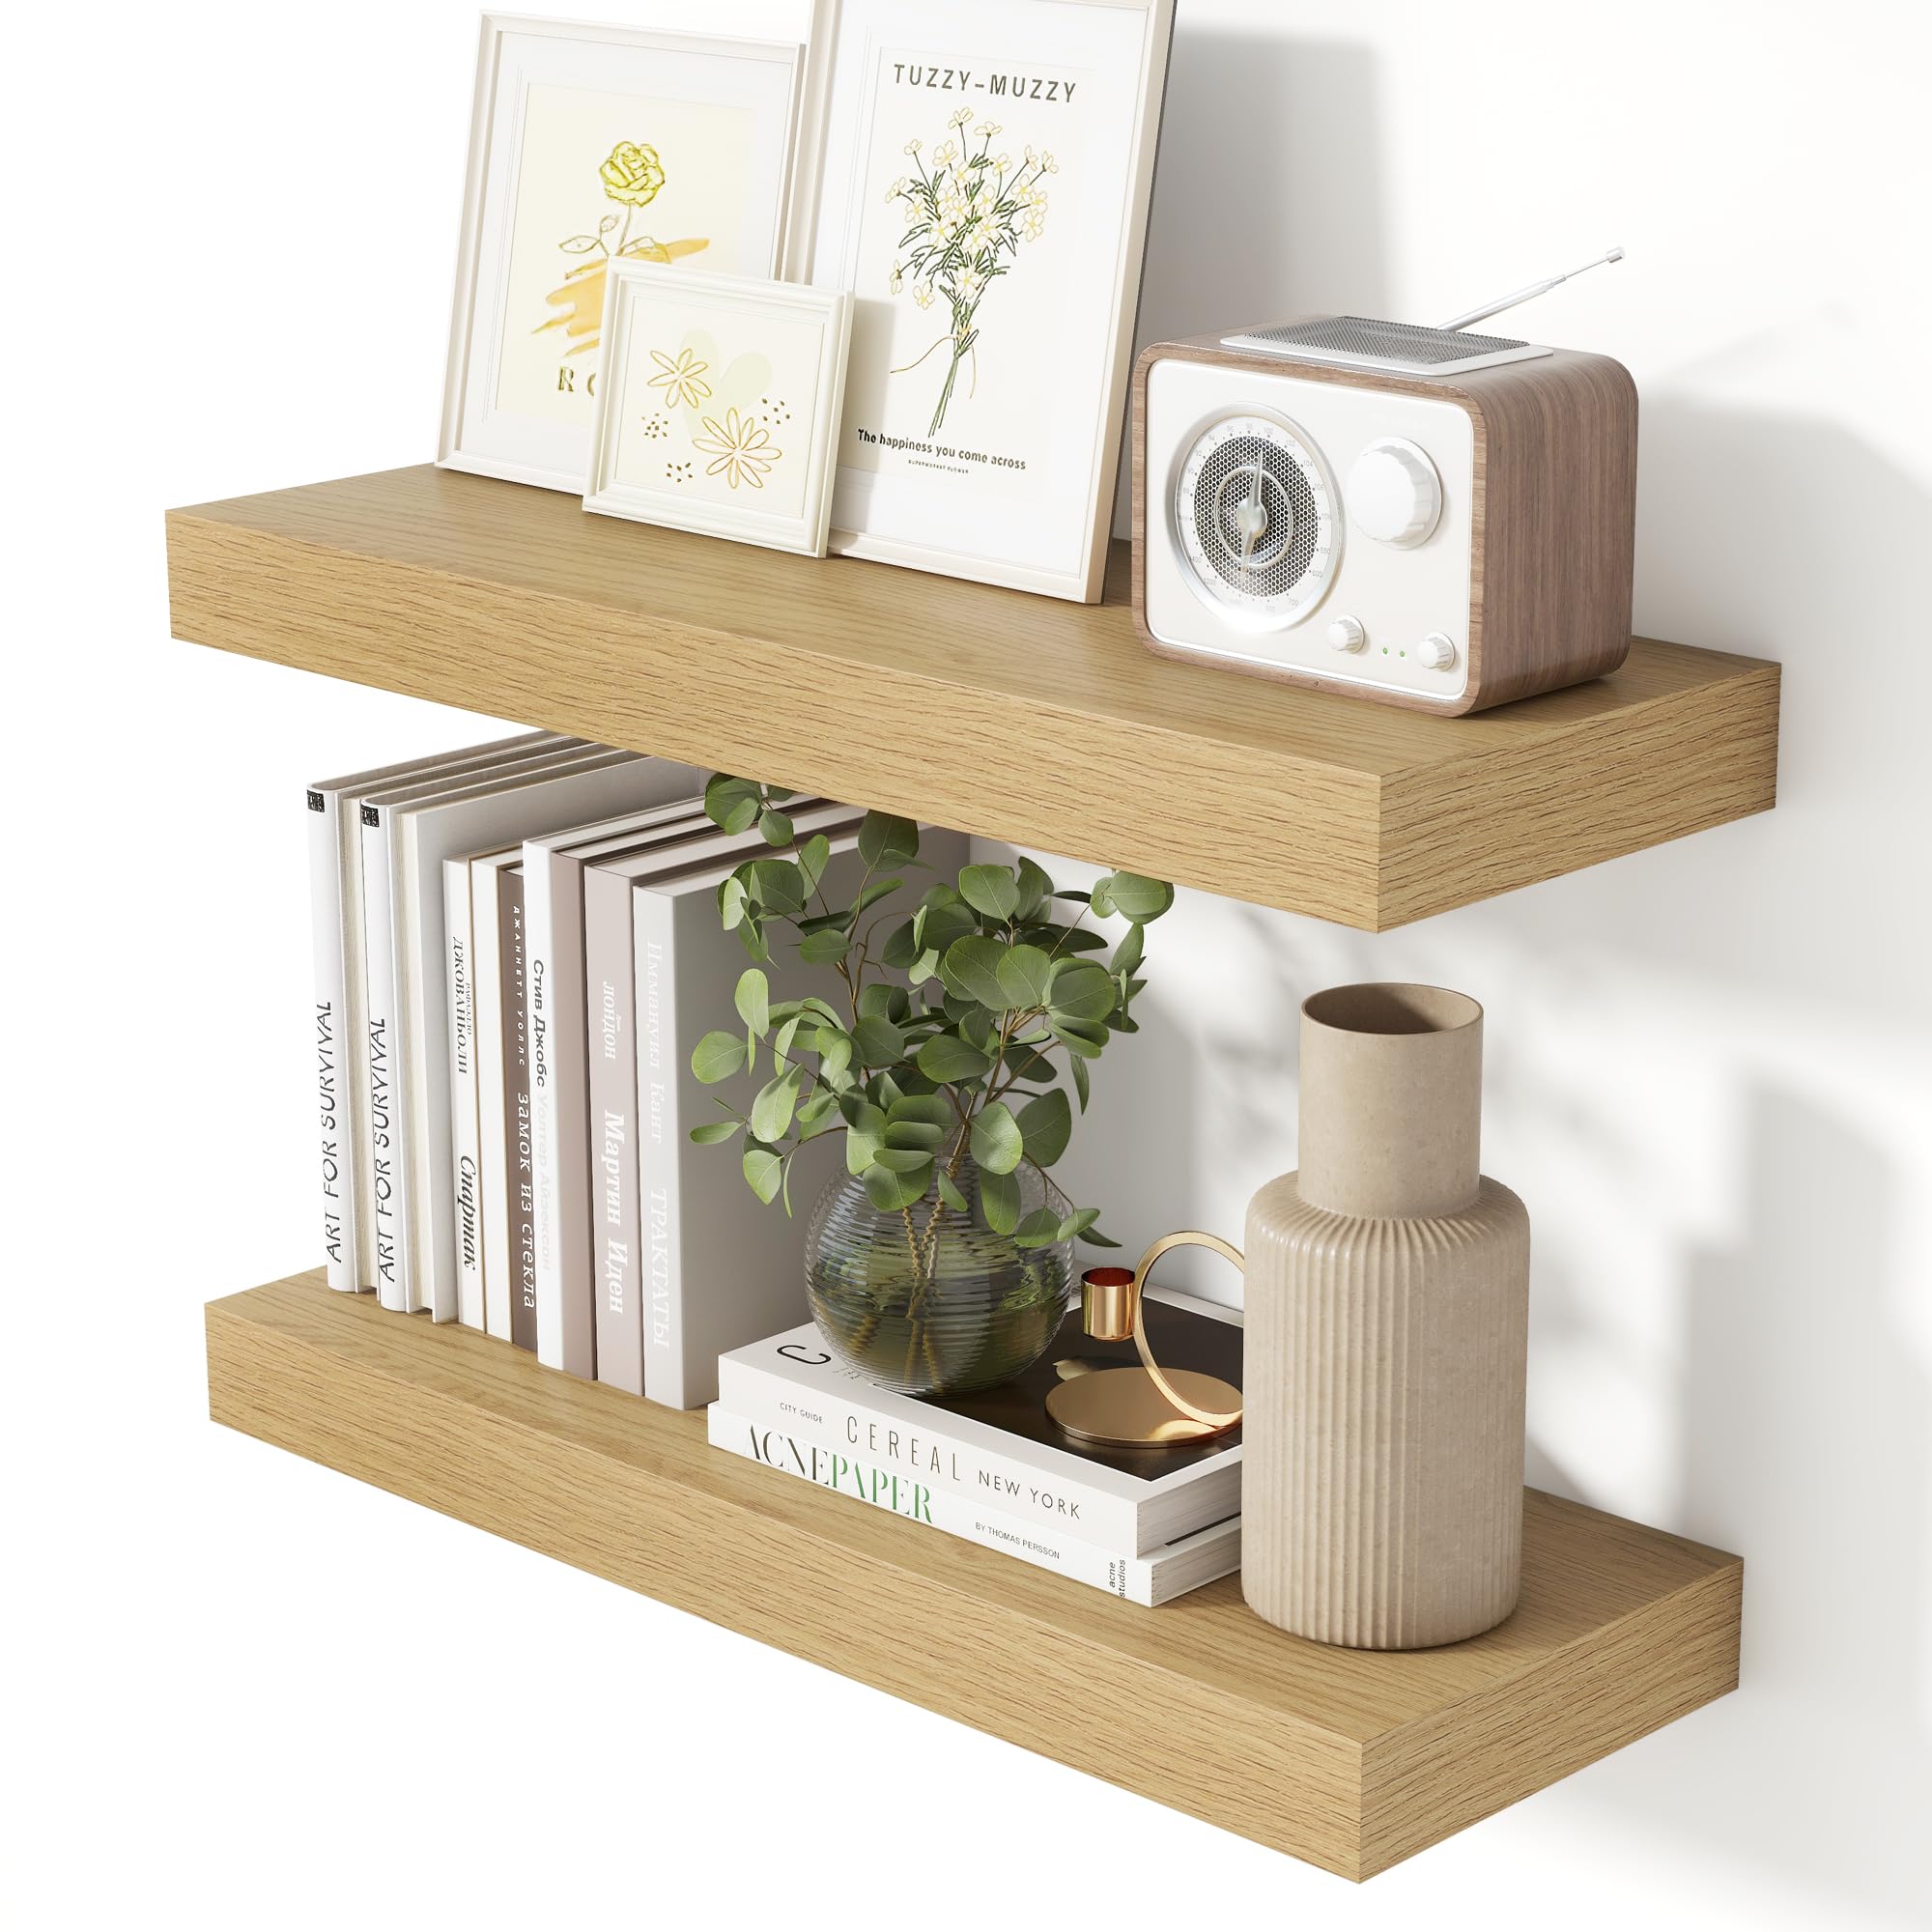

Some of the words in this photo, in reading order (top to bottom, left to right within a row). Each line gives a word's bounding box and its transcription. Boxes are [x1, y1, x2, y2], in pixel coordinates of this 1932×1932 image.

[858, 429, 876, 443] The
[879, 433, 933, 454] happiness
[936, 444, 955, 458] you
[958, 449, 987, 464] come
[990, 455, 1026, 470] across
[513, 906, 524, 999] ДЖАННЕТТ
[453, 937, 469, 1074] ДЖОВАНЬОЛИ
[533, 959, 547, 1009] Стив
[316, 1001, 336, 1131] SURVIVAL
[517, 1009, 526, 1066] УОЛЛС
[533, 1014, 548, 1088] Джобс
[371, 1018, 390, 1149] SURVIVAL
[649, 1082, 665, 1144] Кант
[323, 1142, 339, 1200] FOR
[376, 1160, 392, 1217] FOR
[600, 1109, 625, 1227] Мартин
[457, 1155, 478, 1270] Спартак
[521, 1183, 535, 1212] из
[325, 1211, 342, 1264] ART
[379, 1228, 395, 1283] ART
[607, 1238, 628, 1314] Иден
[650, 1187, 669, 1350] ТРАКТАТЫ
[780, 1402, 799, 1415] CITY
[800, 1408, 823, 1424] GUIDE
[847, 1415, 962, 1482] CEREAL
[979, 1468, 1021, 1497] NEW
[1030, 1487, 1081, 1520] YORK
[975, 1521, 986, 1532] BY
[987, 1526, 1021, 1547] THOMAS
[1022, 1539, 1061, 1560] PERSSON
[1108, 1561, 1117, 1589] acne
[1118, 1558, 1126, 1598] studios
